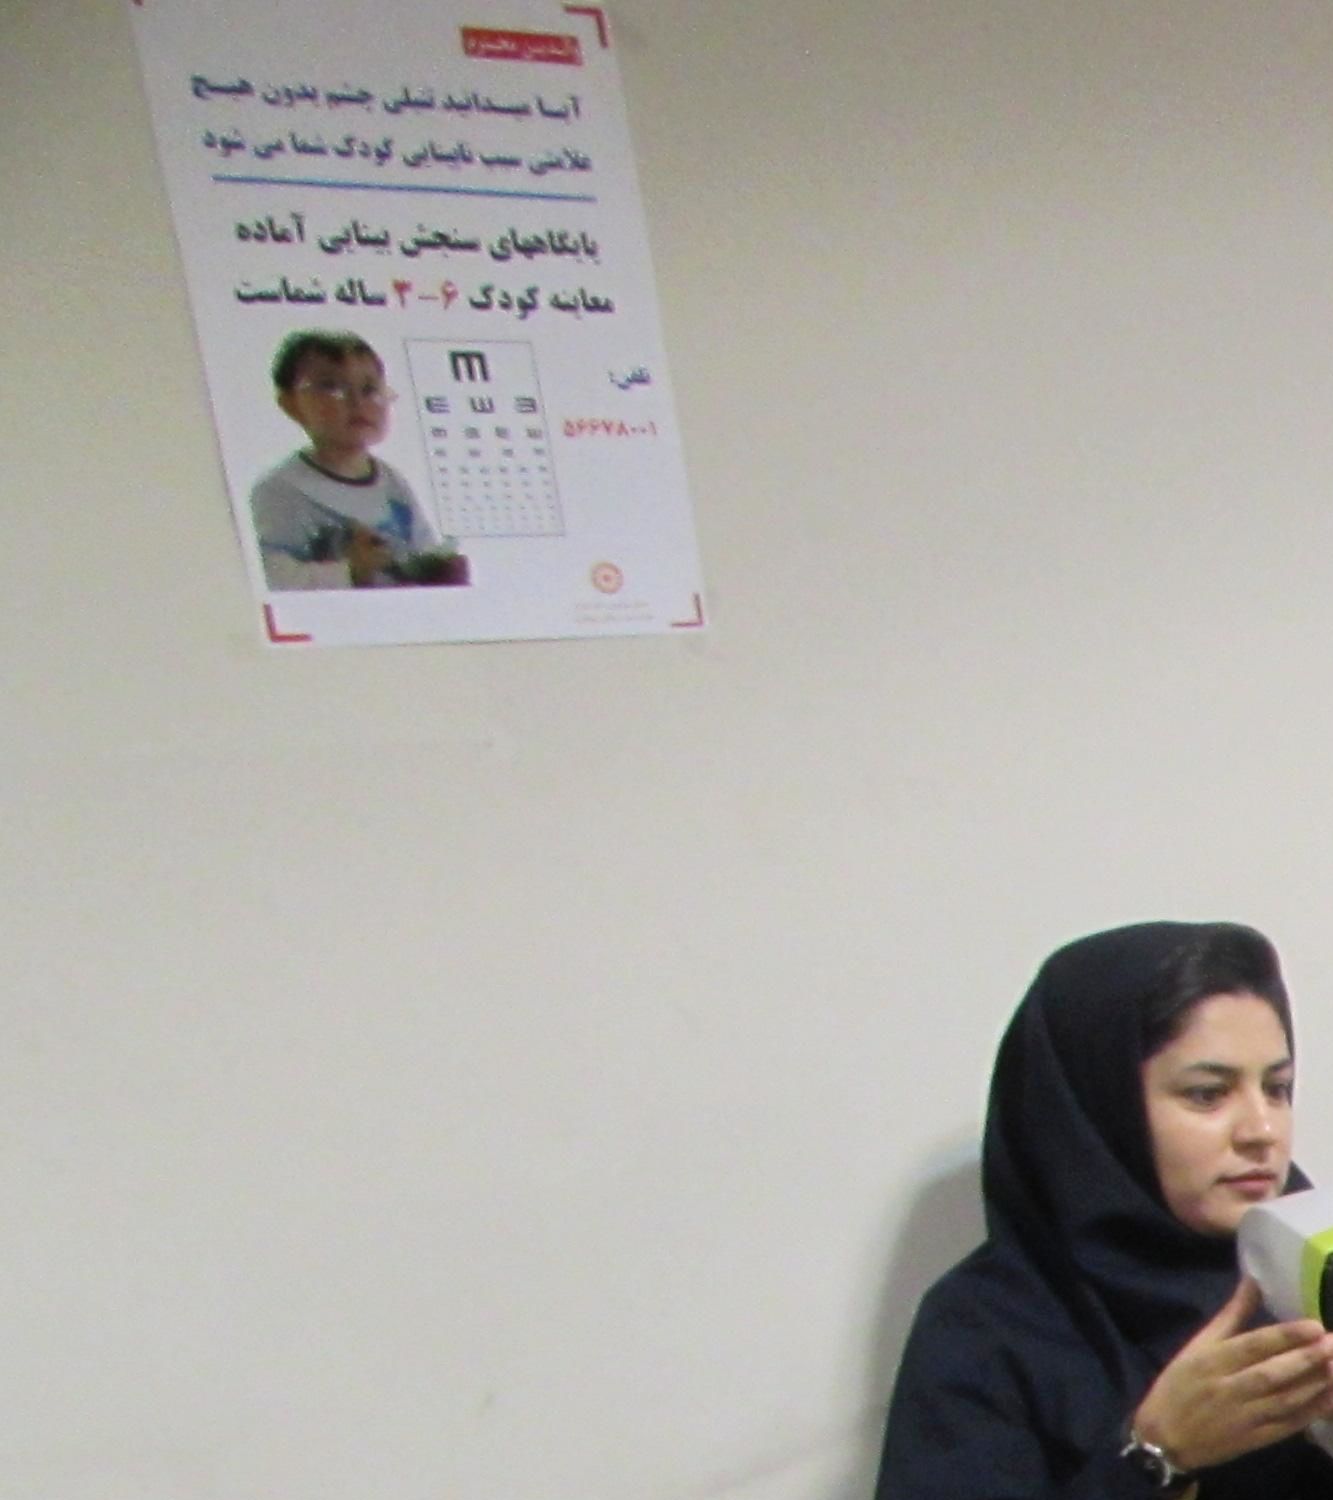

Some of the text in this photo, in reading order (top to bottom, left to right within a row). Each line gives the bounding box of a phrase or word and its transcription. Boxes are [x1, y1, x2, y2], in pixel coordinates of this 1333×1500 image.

[235, 211, 305, 243] آماده
[400, 222, 481, 259] سنجش
[334, 276, 387, 307] ساله
[468, 283, 540, 320] کودک
